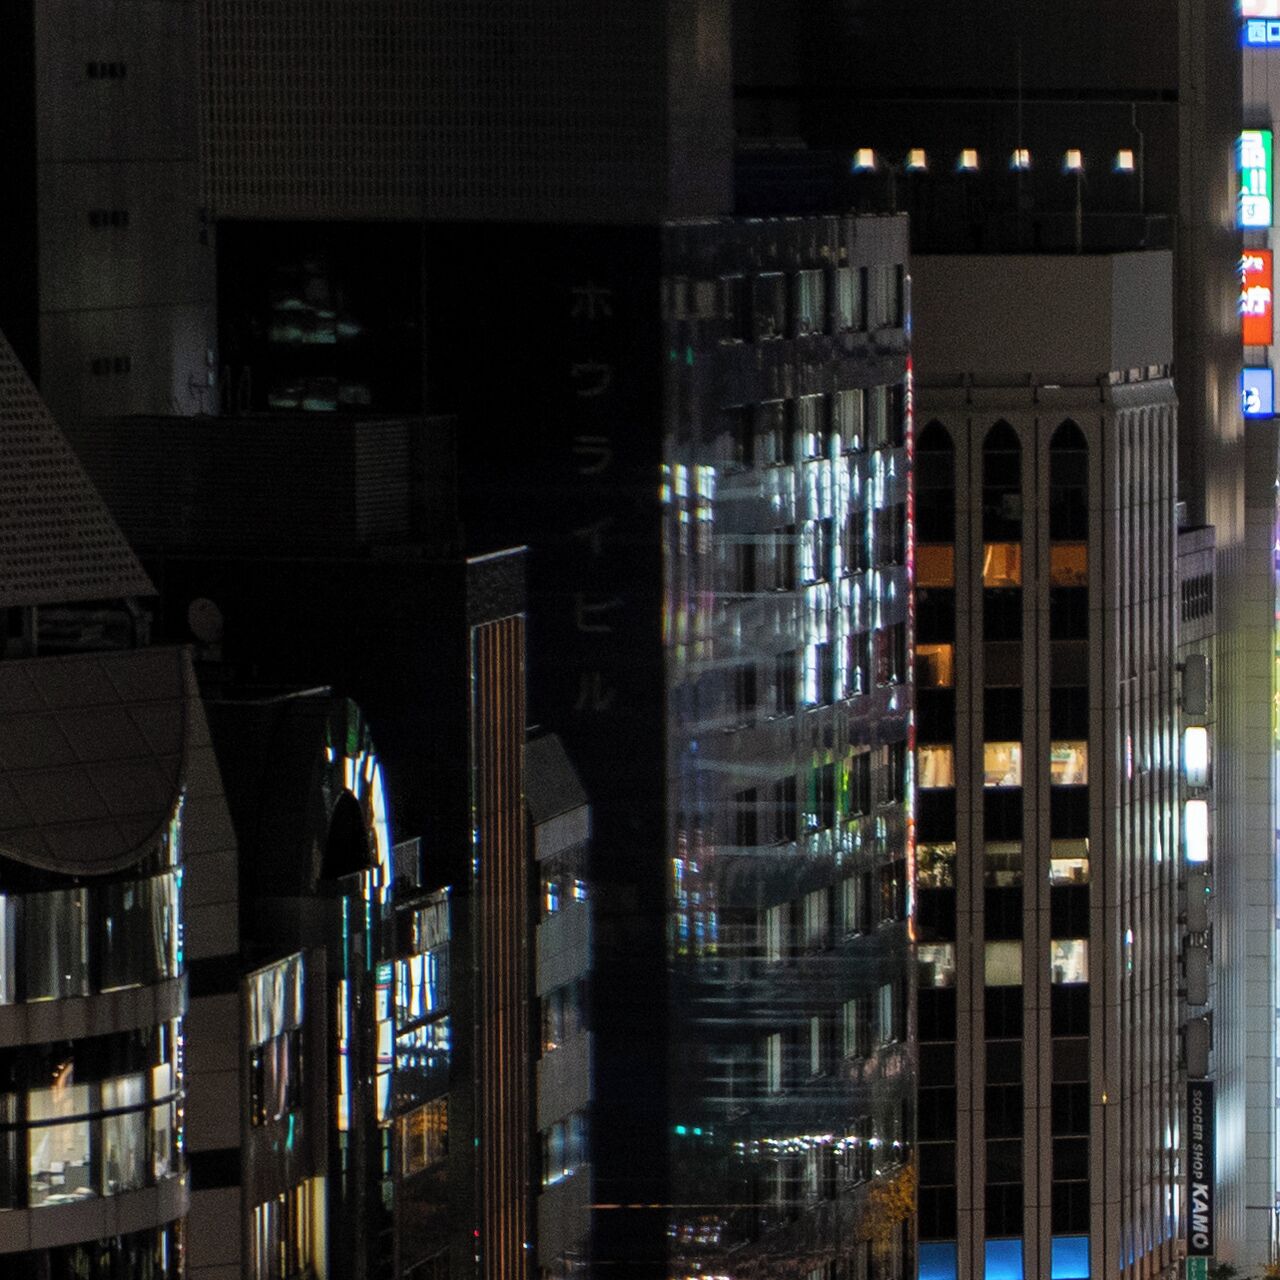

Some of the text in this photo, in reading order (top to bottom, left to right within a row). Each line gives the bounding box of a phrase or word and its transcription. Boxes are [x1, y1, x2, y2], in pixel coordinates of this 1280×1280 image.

[571, 281, 623, 710] ホウライビル
[1192, 1089, 1204, 1141] SOCCER
[1192, 1144, 1203, 1180] SHOP
[1192, 1182, 1209, 1250] KAMO
